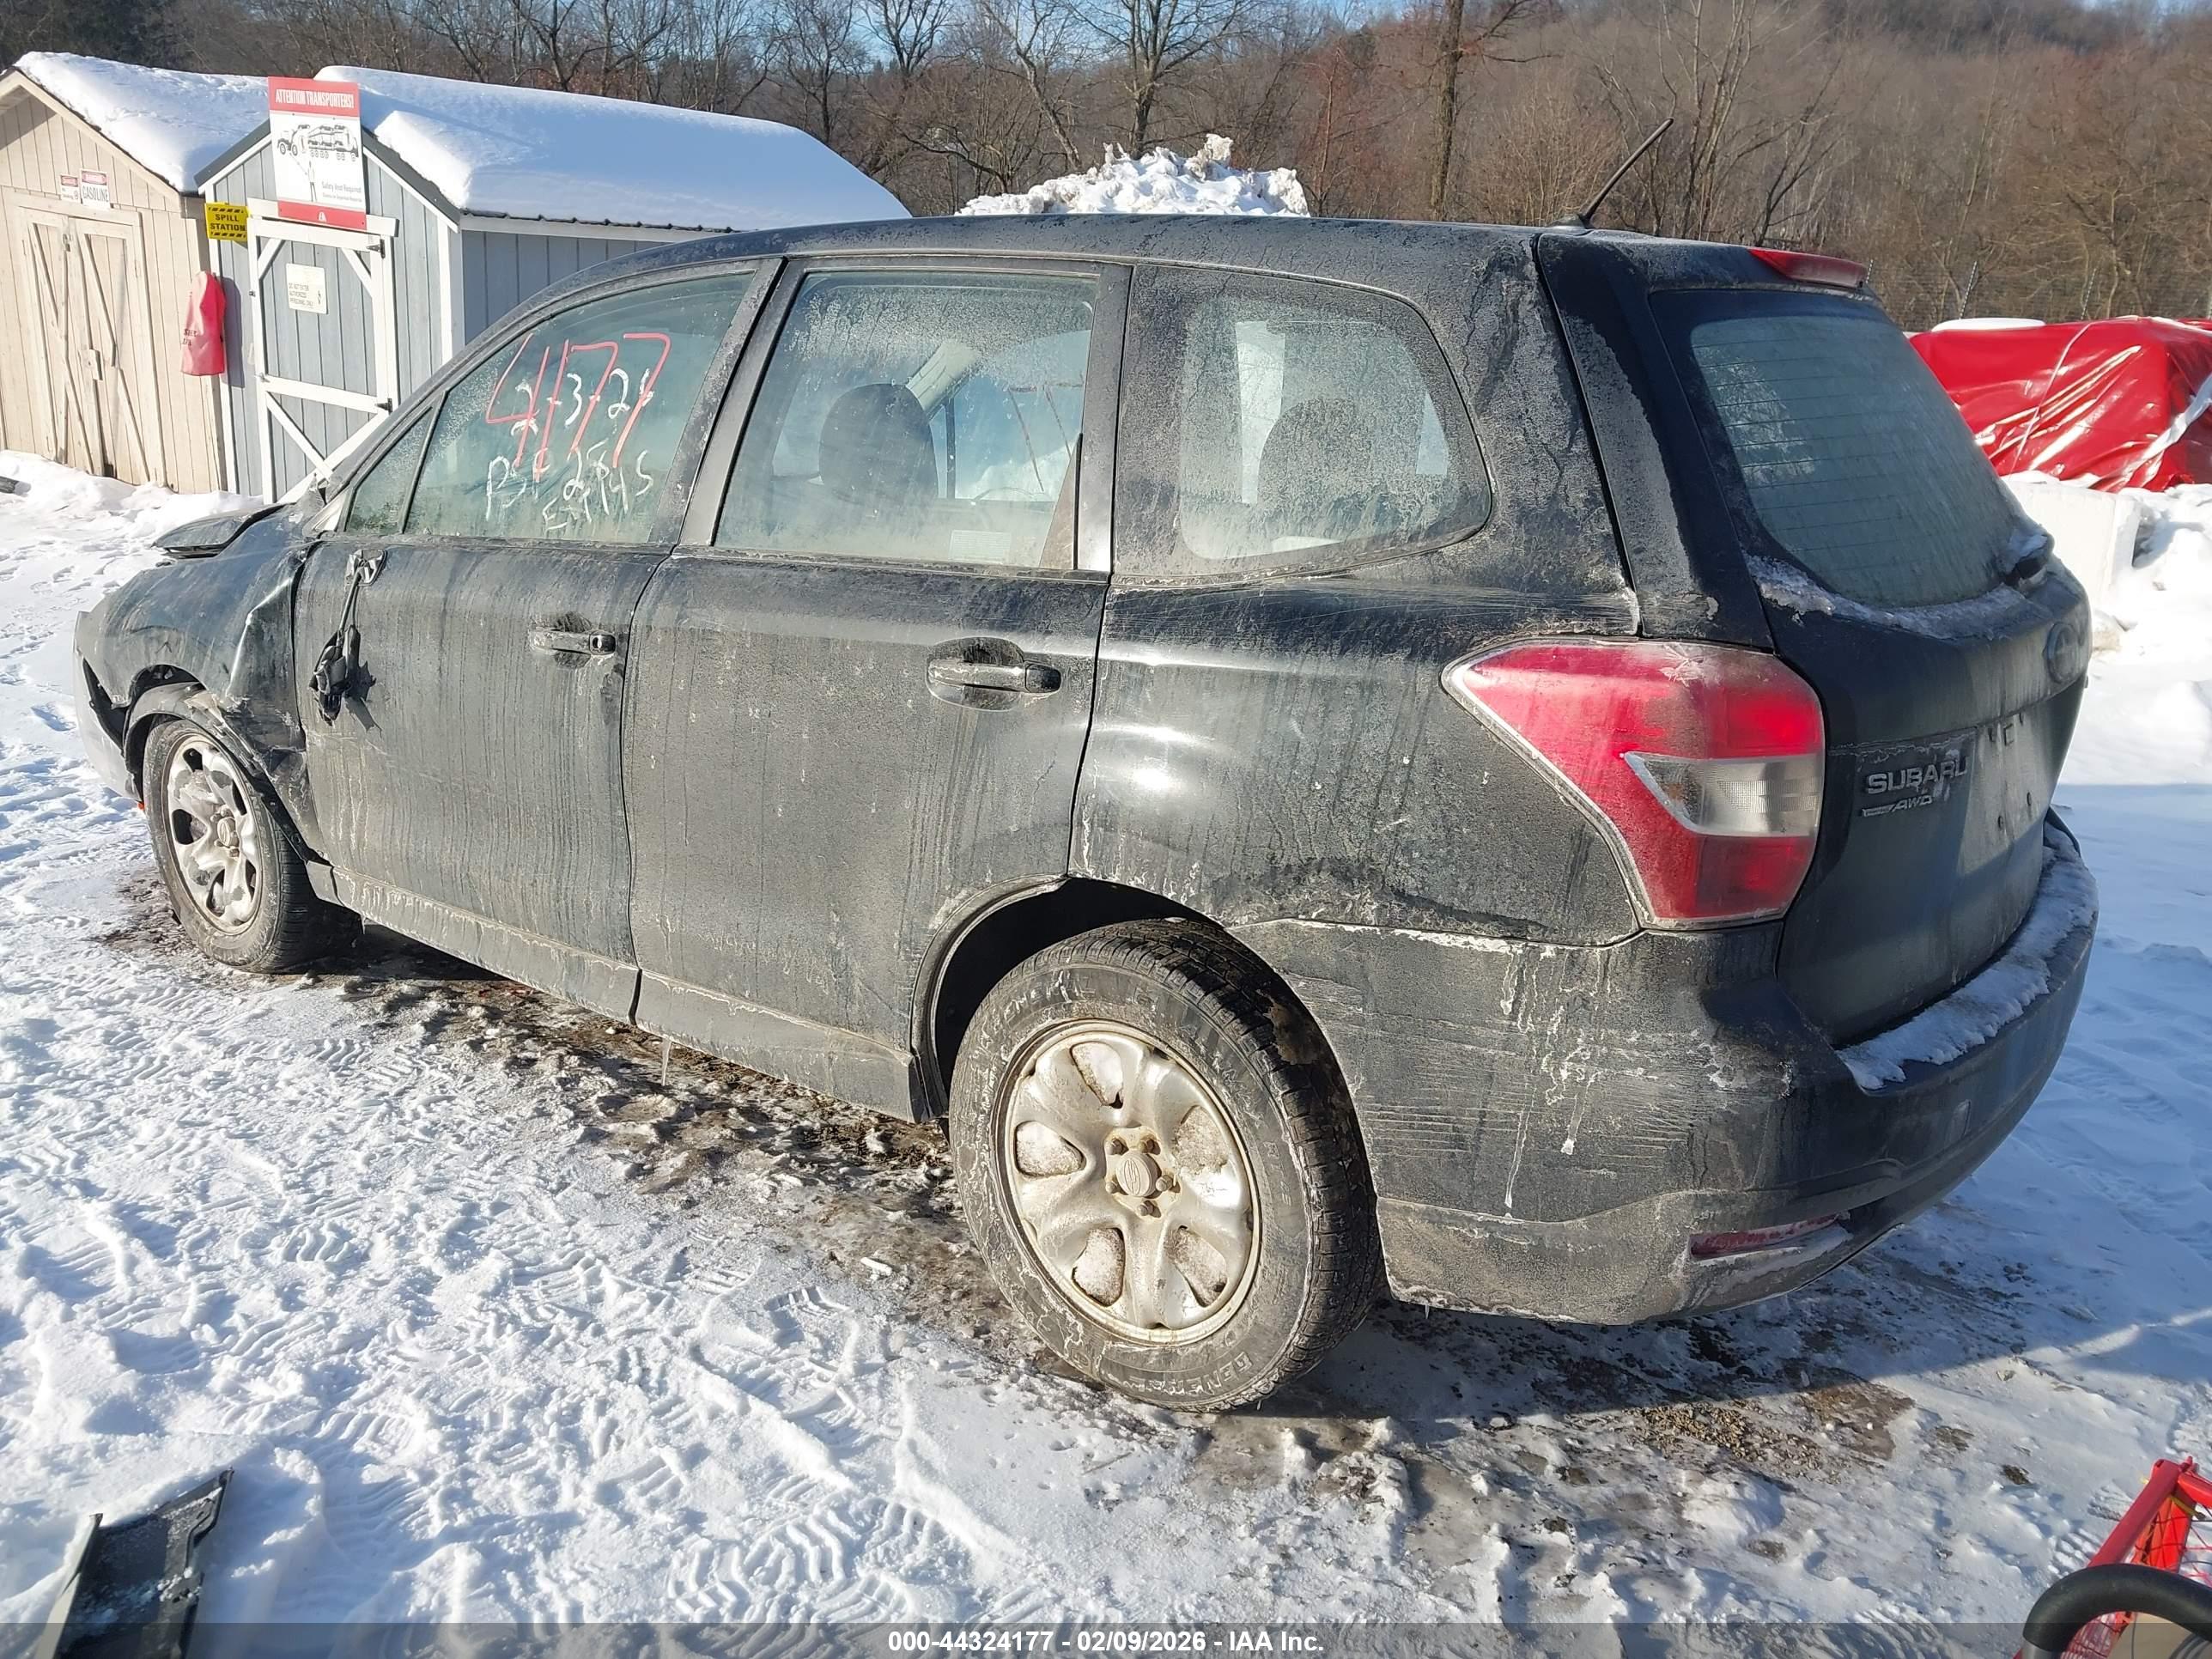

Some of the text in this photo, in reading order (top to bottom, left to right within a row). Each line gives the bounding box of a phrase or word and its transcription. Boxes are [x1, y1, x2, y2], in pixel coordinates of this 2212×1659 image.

[276, 88, 354, 108] ATTENTION TRANSPORTERS!
[82, 185, 108, 203] GASOLINE
[210, 222, 246, 231] STATION
[215, 213, 240, 222] SPILL
[485, 332, 672, 483] 4177
[1868, 755, 1968, 794] SUBARU
[1892, 794, 1934, 813] AWD
